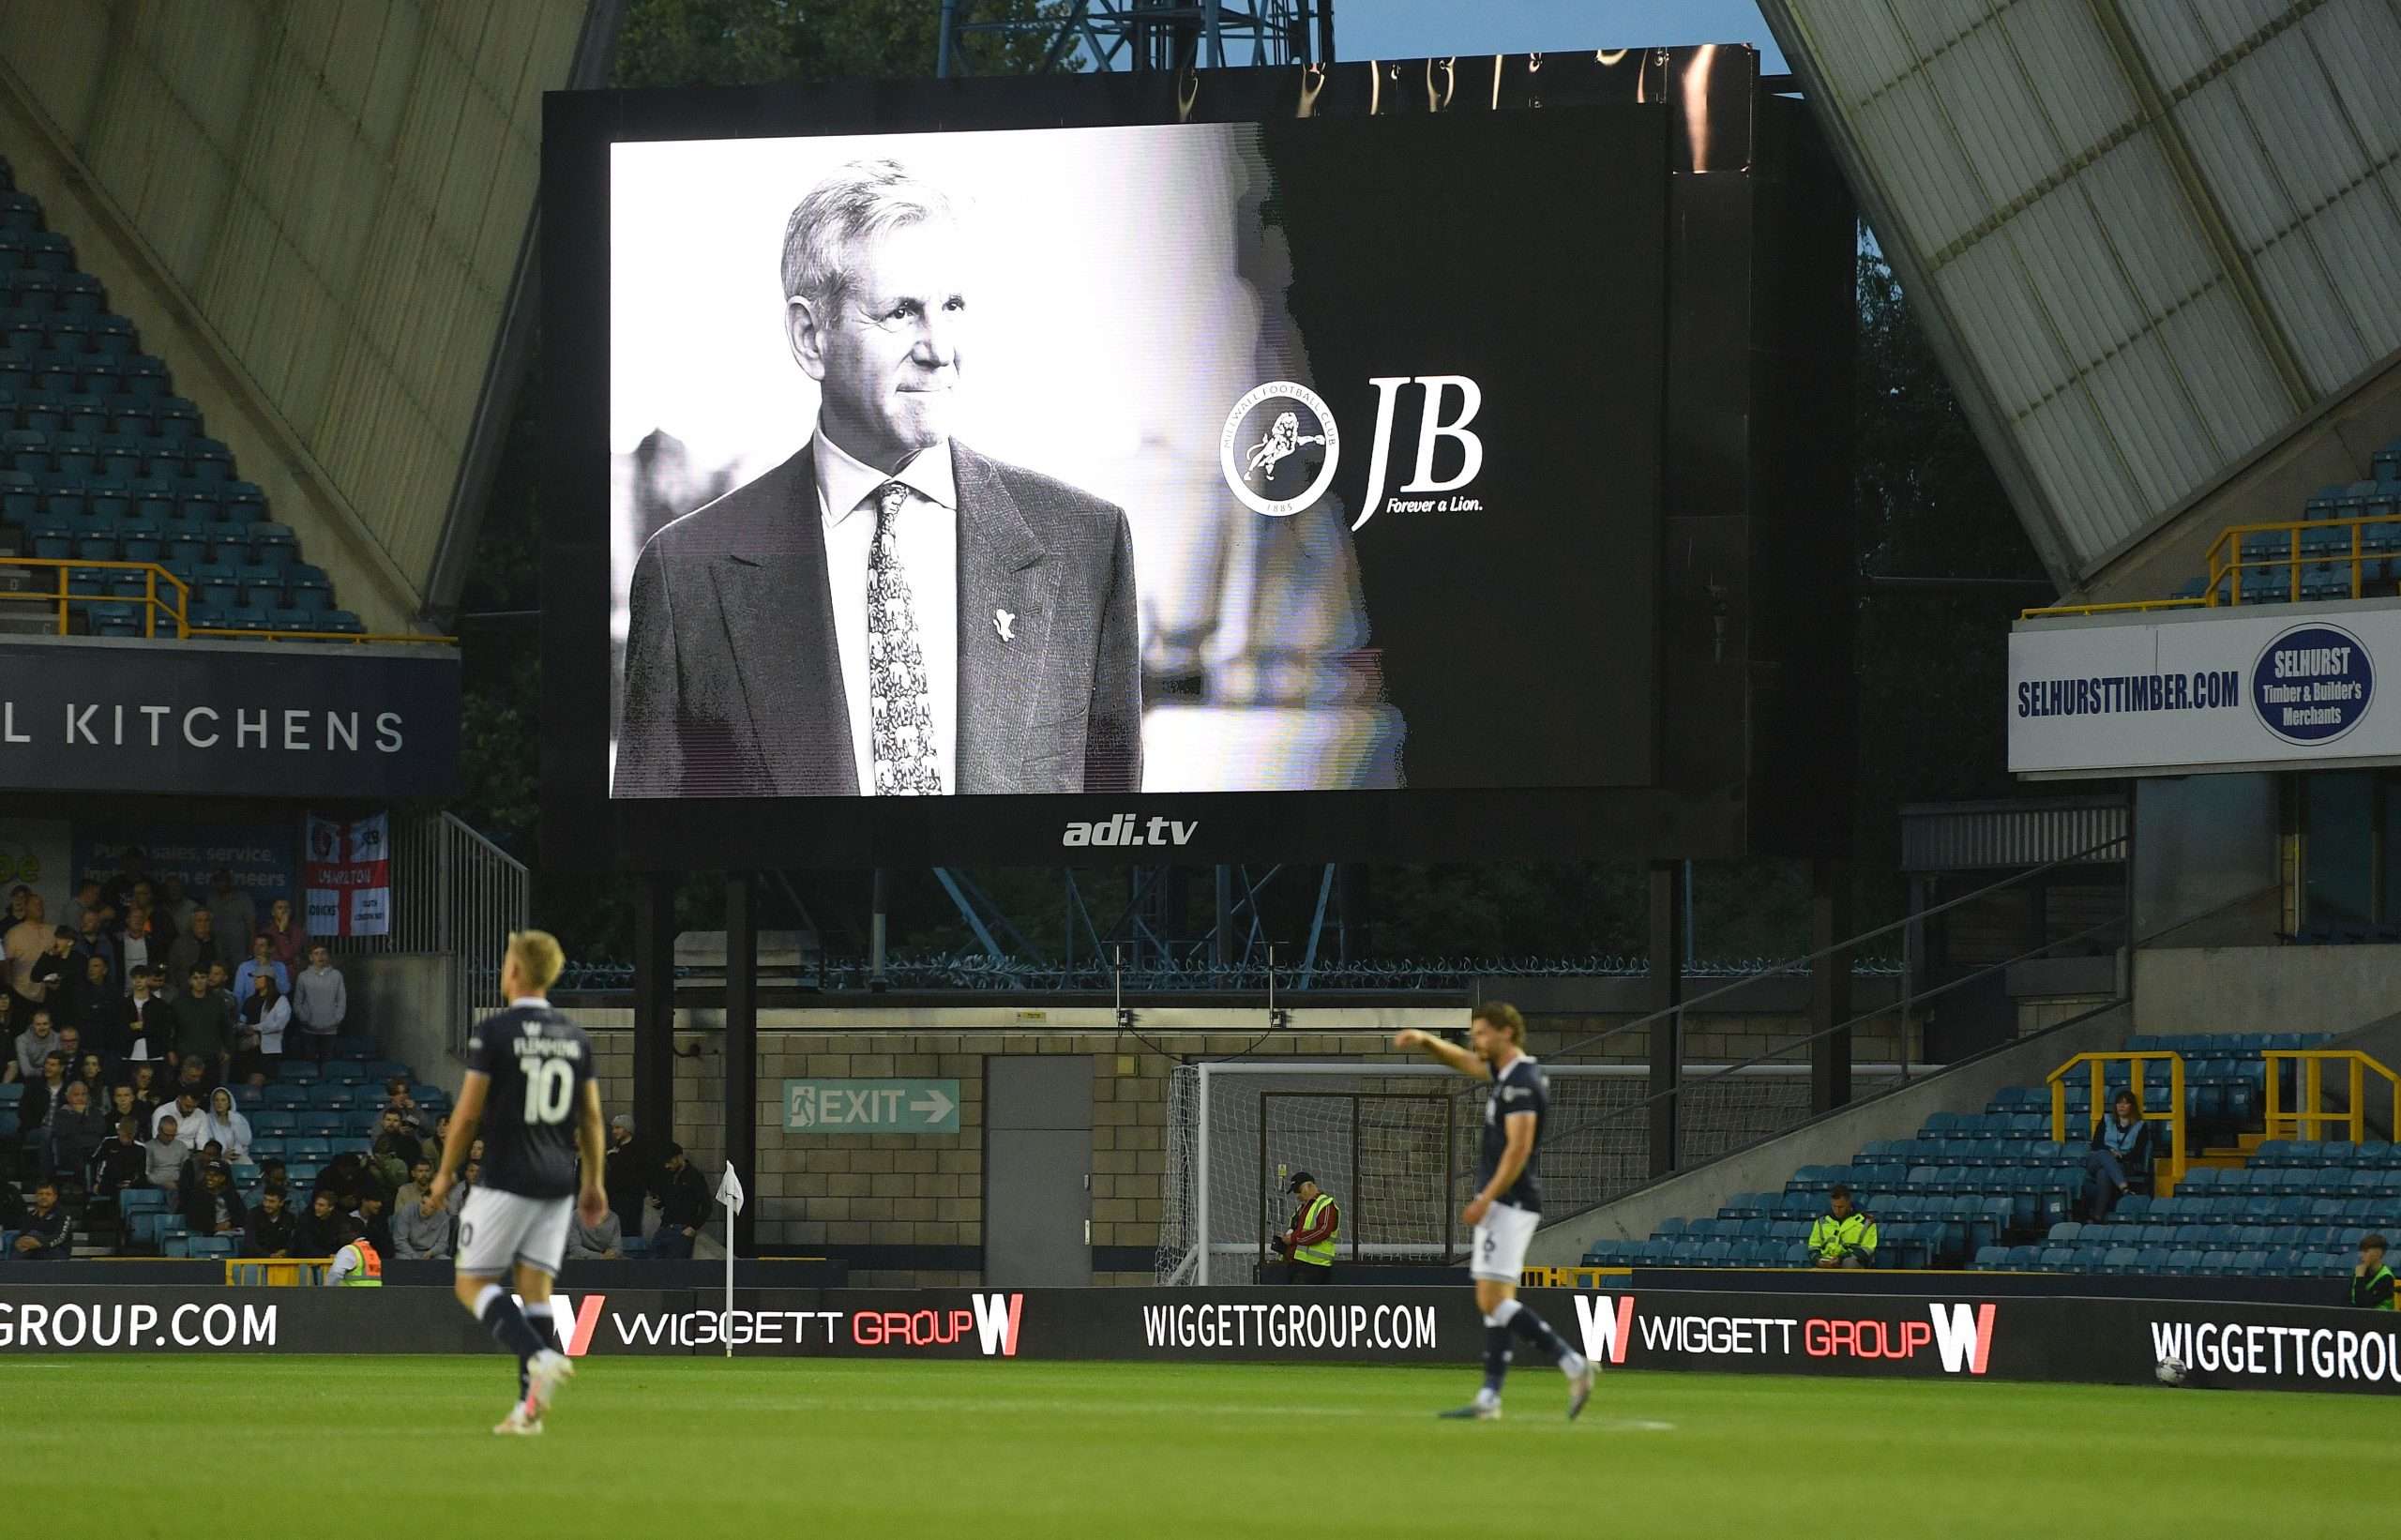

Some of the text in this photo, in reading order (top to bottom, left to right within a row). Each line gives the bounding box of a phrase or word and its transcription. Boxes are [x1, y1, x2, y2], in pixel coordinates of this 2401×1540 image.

[1261, 384, 1322, 411] FOOTBALL
[1321, 411, 1337, 446] CLUB
[1351, 375, 1483, 532] JB
[1266, 503, 1293, 513] 1885
[1386, 495, 1484, 513] Forever a Lion.
[2274, 647, 2351, 678] SELHURST
[2017, 671, 2239, 717] SELHURSTTIMBER.COM
[2263, 680, 2362, 703] Timber & Builder's
[5, 702, 403, 752] L KITCHENS
[2283, 706, 2342, 726] Merchants
[1063, 813, 1199, 847] adi.tv
[520, 1058, 575, 1125] 10
[820, 1090, 906, 1124] EXIT
[612, 1310, 843, 1346] WIGGETT
[853, 1310, 973, 1345] GROUP
[1143, 1305, 1436, 1349] WIGGETTGROUP.COM
[1638, 1316, 1798, 1353] WIGGETT
[1805, 1319, 1930, 1358] GROUP
